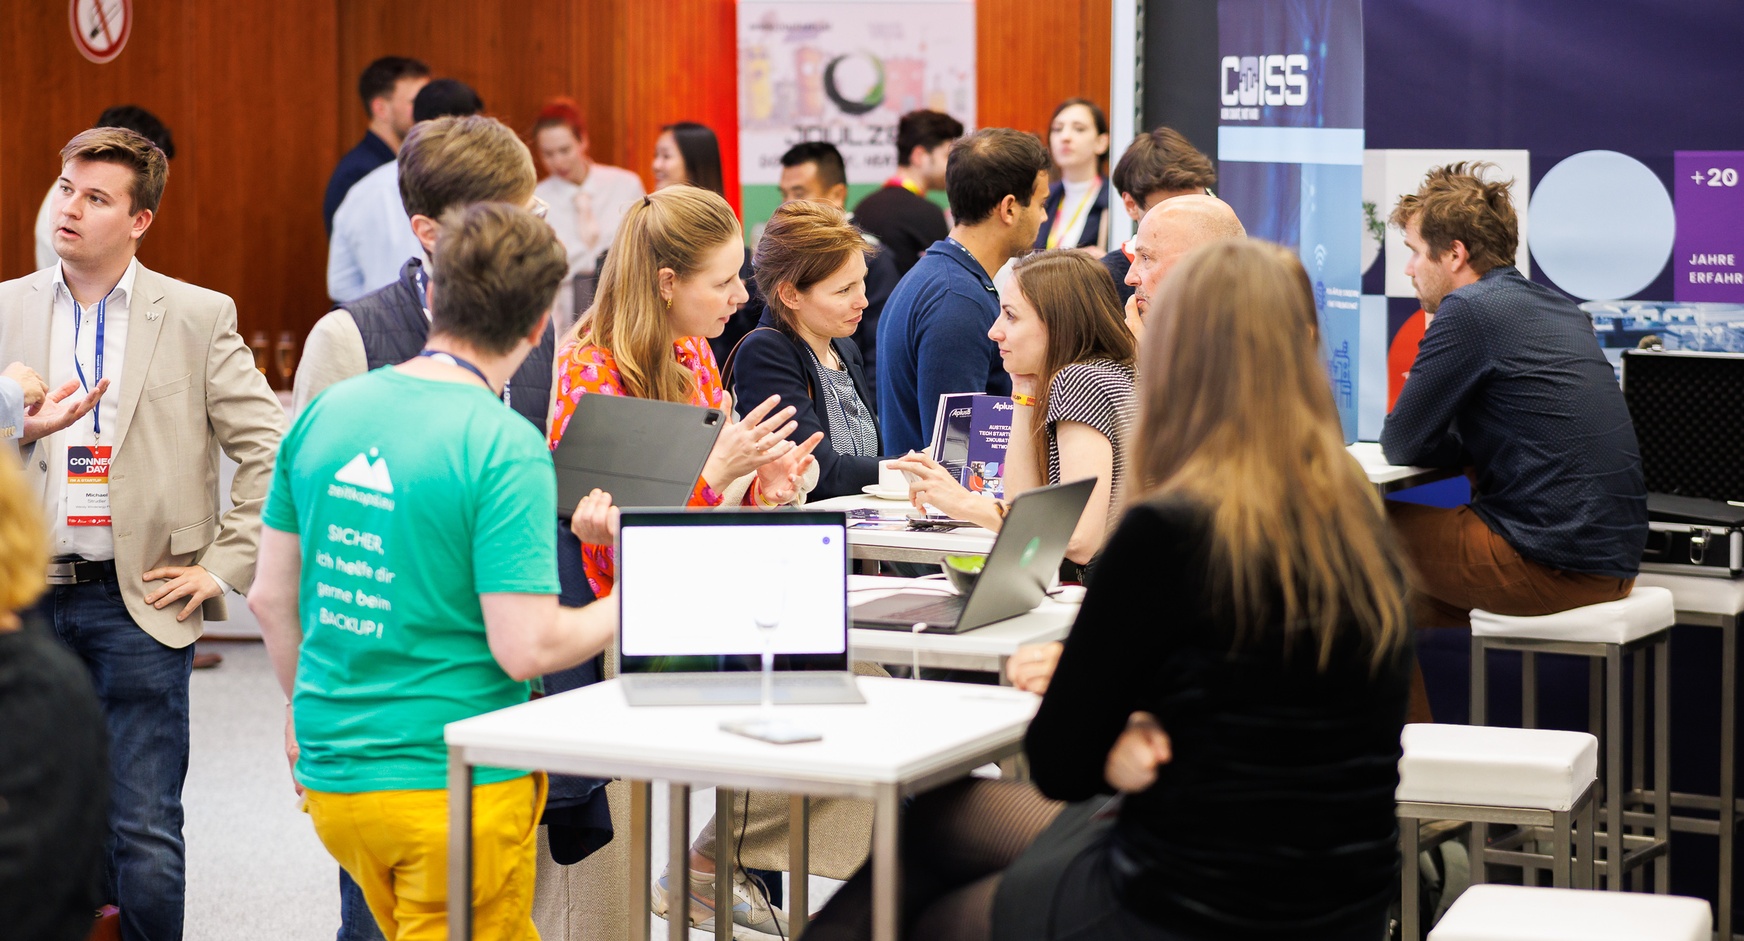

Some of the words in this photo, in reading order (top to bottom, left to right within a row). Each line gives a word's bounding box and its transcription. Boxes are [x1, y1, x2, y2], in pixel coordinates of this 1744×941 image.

[1689, 254, 1735, 266] JAHRE
[1689, 272, 1743, 284] ERFAHR
[316, 549, 334, 569] ich
[336, 556, 373, 579] helfe
[375, 566, 396, 583] dir
[355, 589, 391, 611] beim
